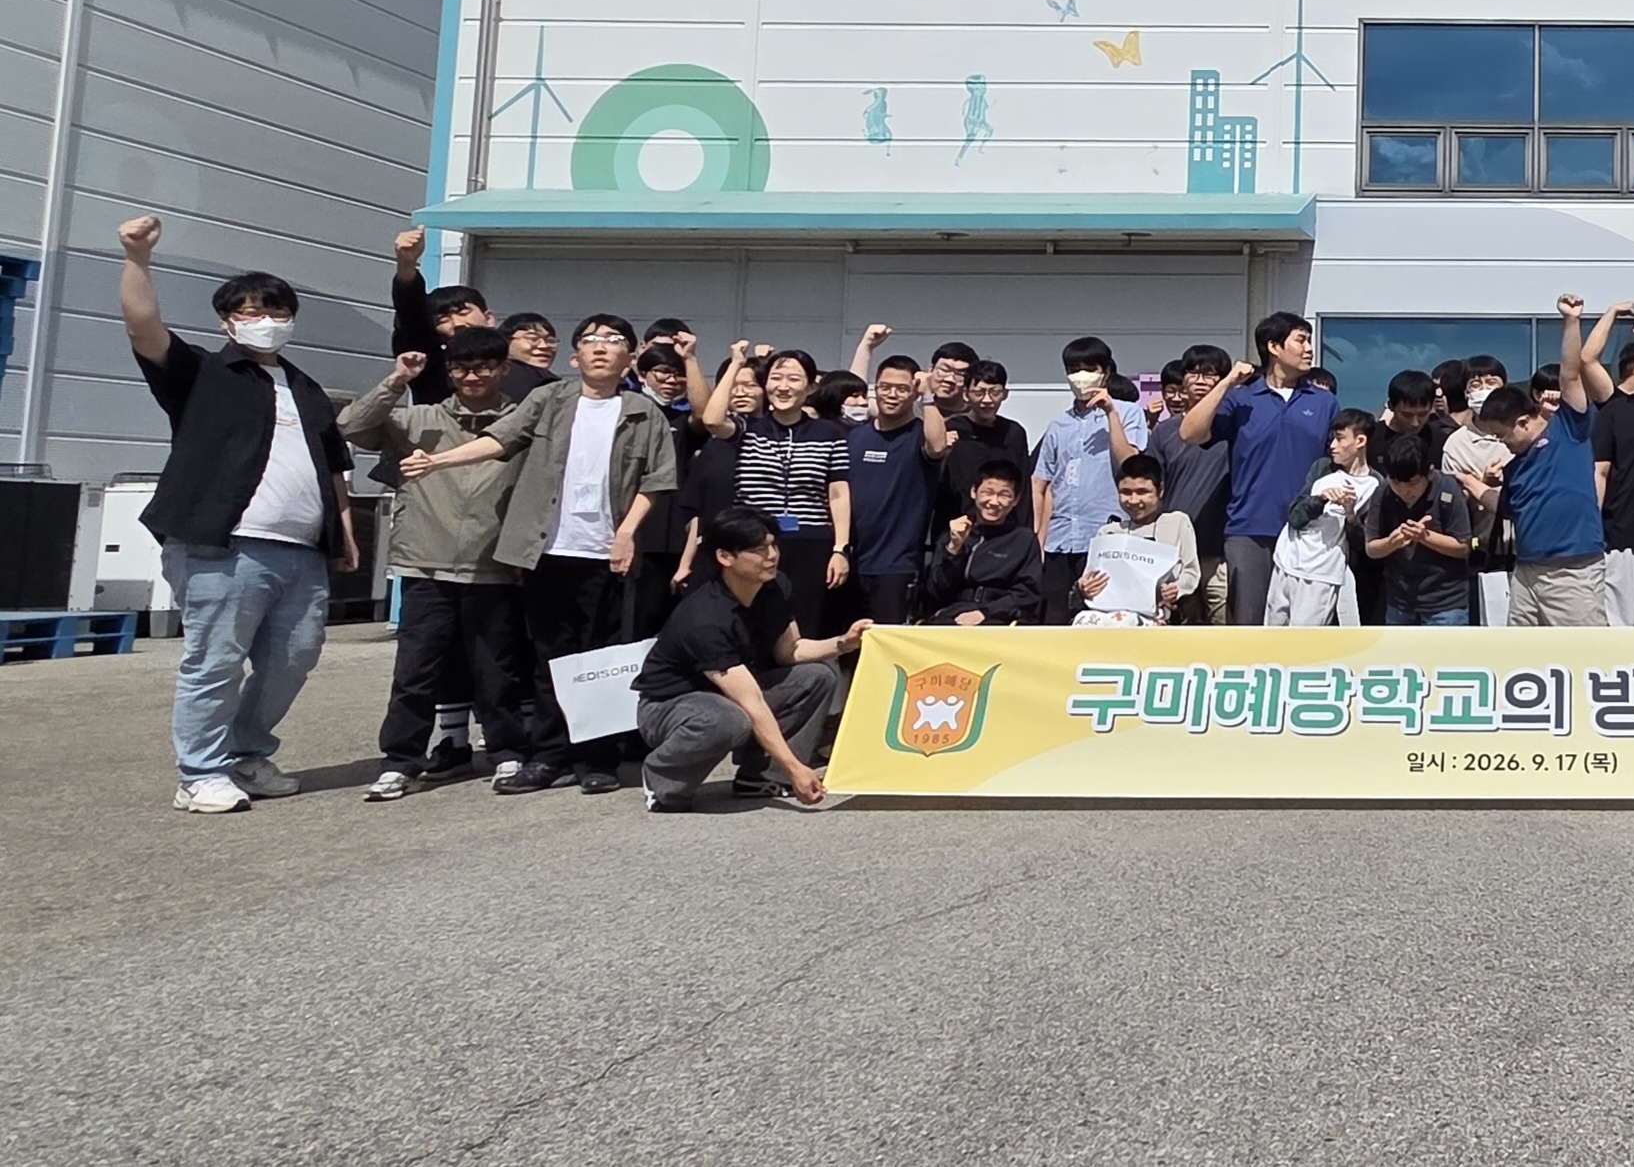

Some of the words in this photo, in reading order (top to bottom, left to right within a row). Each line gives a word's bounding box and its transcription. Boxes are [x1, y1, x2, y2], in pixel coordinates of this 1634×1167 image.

[914, 675, 972, 690] 구미혜당
[1067, 662, 1573, 737] 구미혜당학교의
[914, 734, 950, 744] 1985
[1406, 752, 1445, 773] 일시
[1463, 753, 1526, 772] 2026.
[1531, 753, 1550, 772] 9.
[1555, 753, 1577, 772] 17
[1583, 751, 1619, 774] (목)
